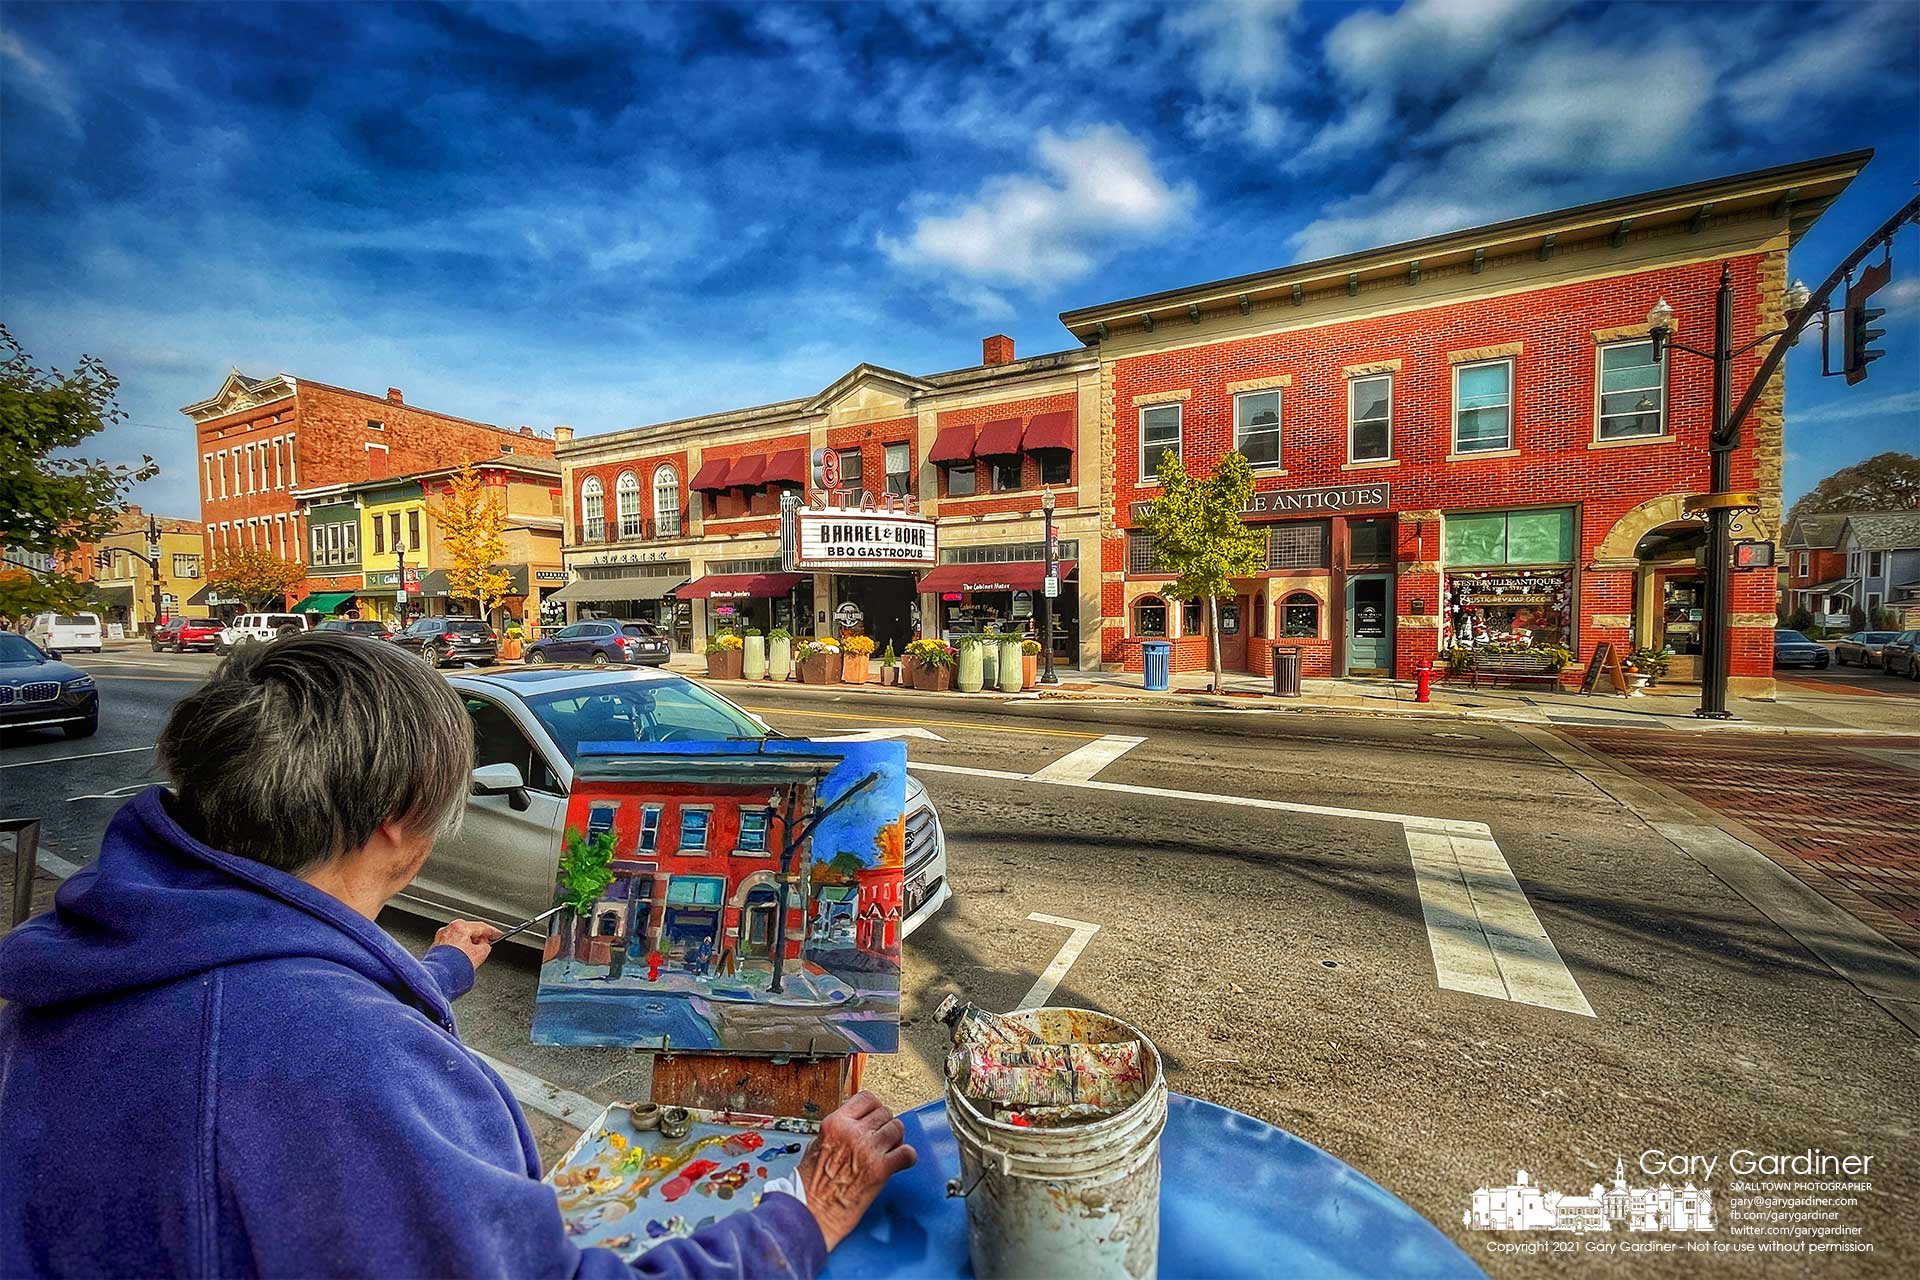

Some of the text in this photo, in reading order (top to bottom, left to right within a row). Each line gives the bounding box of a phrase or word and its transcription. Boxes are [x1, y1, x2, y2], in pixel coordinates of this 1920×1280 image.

[808, 488, 919, 516] STATE
[1272, 488, 1383, 512] ANTIQUES
[820, 525, 926, 548] BARREL & BOAR
[828, 547, 923, 558] BBQ GASTROPUB
[1512, 577, 1562, 586] ANTIQUES
